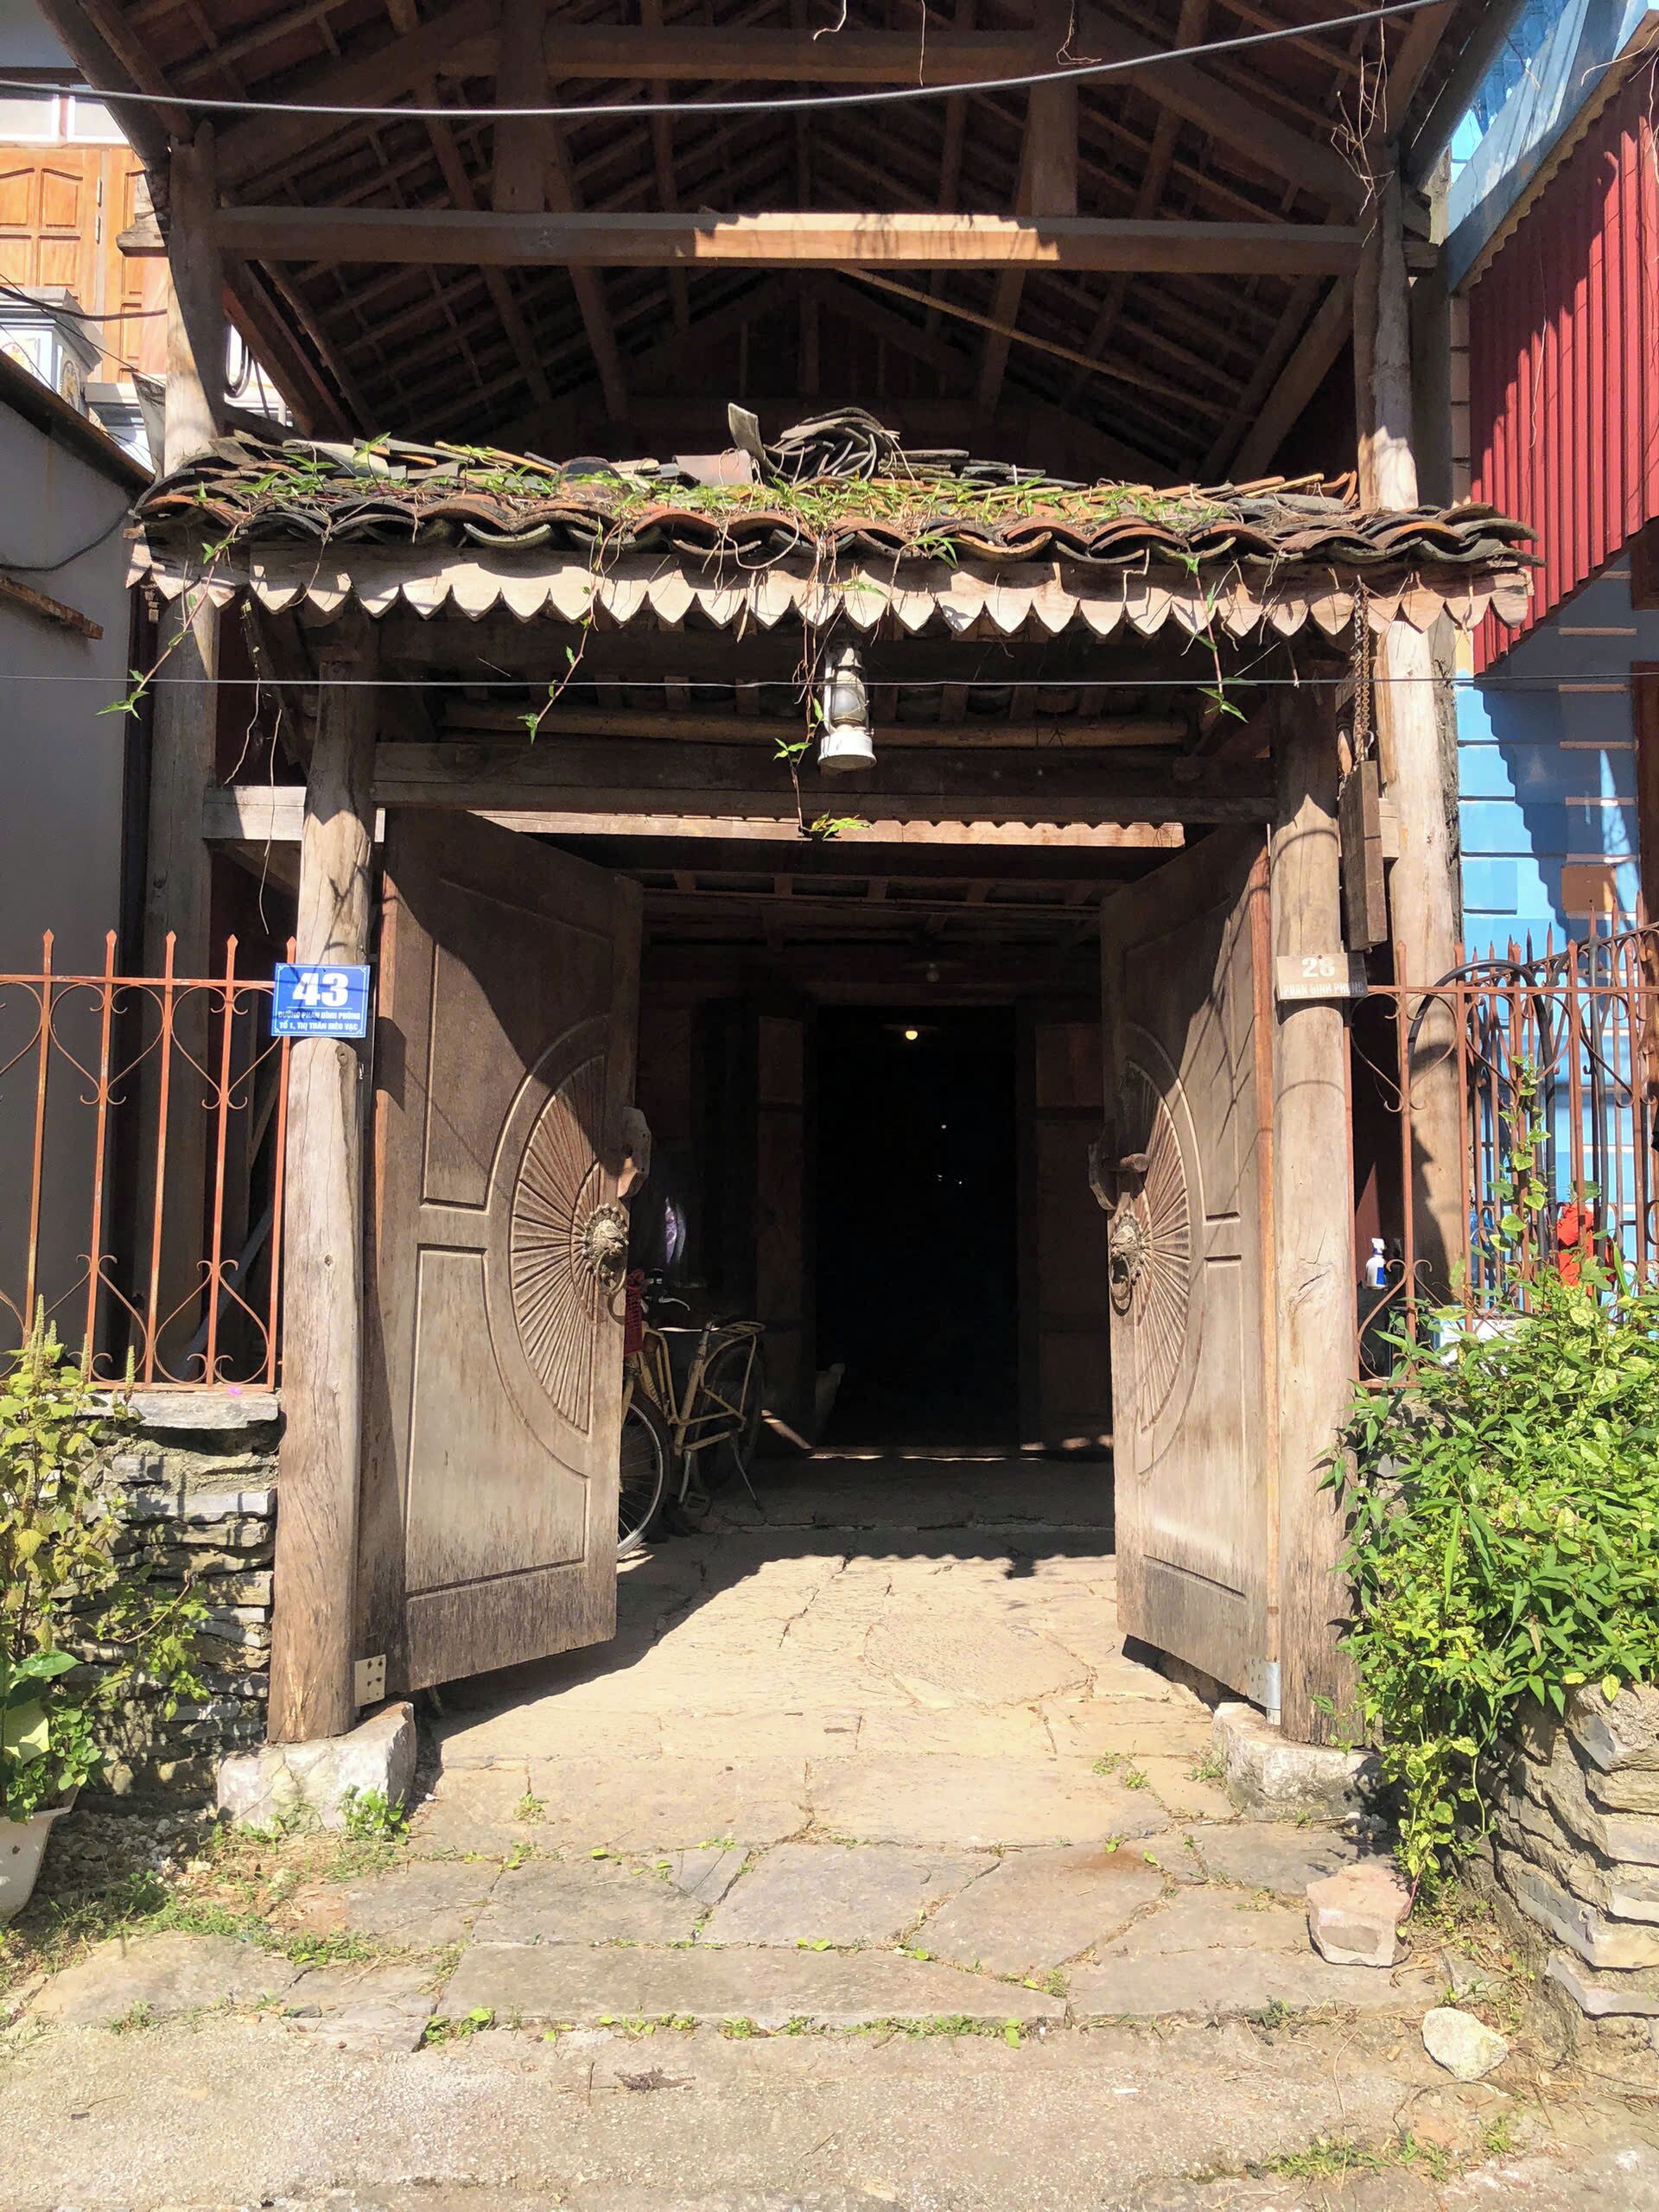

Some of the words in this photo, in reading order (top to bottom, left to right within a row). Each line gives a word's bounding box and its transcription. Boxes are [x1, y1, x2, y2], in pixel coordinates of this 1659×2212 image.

[292, 972, 349, 1007] 43
[297, 1022, 308, 1031] THỊ
[345, 1023, 359, 1032] VẠC
